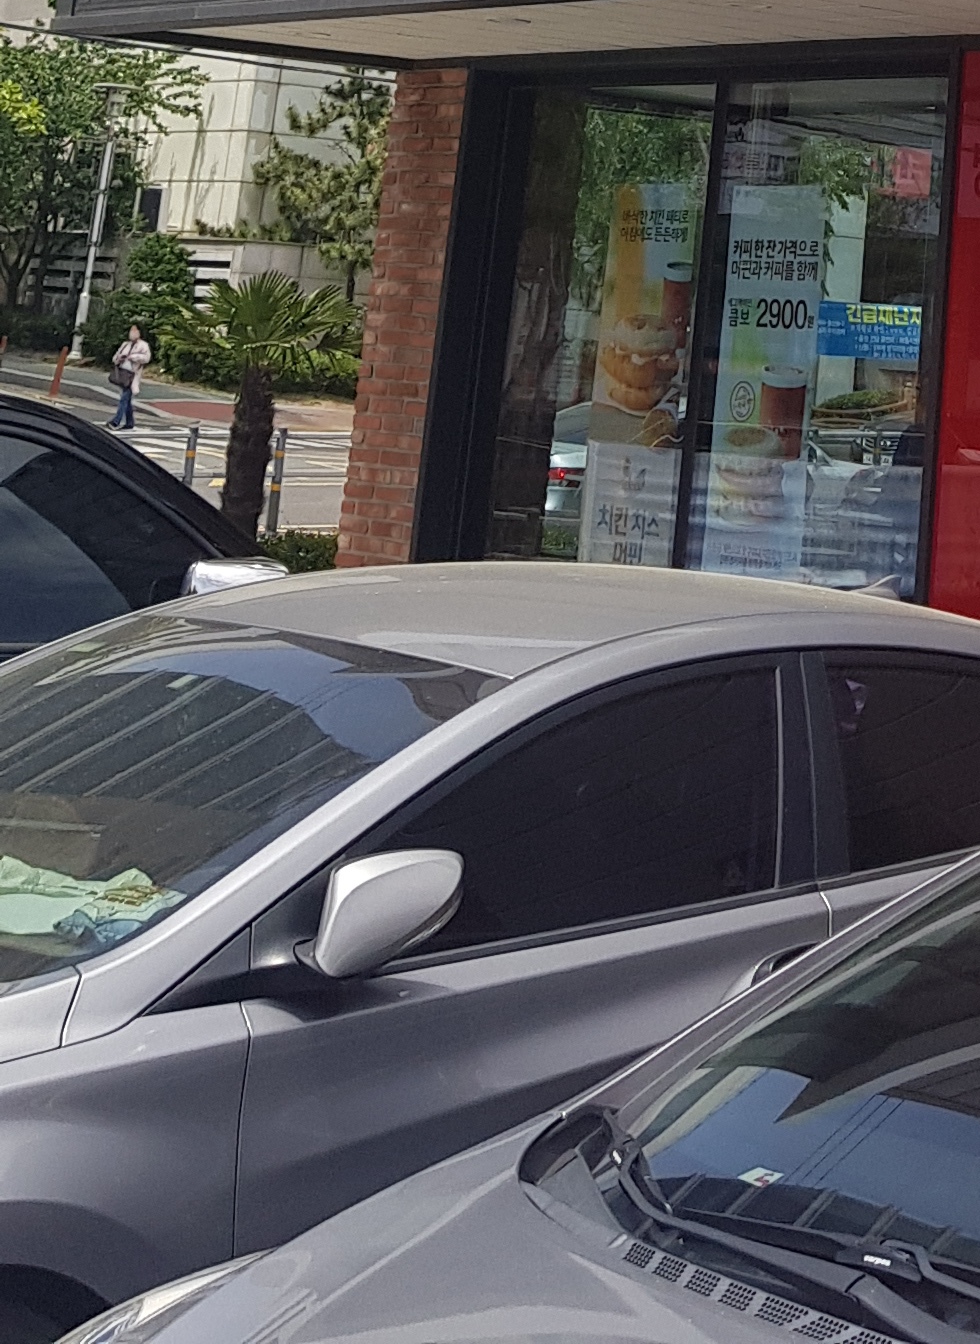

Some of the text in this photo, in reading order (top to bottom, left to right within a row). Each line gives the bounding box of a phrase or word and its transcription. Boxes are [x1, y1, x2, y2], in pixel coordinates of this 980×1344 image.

[777, 239, 819, 259] 가격으로
[732, 260, 819, 282] 머핀과 커피를 함께
[597, 504, 629, 536] 치킨
